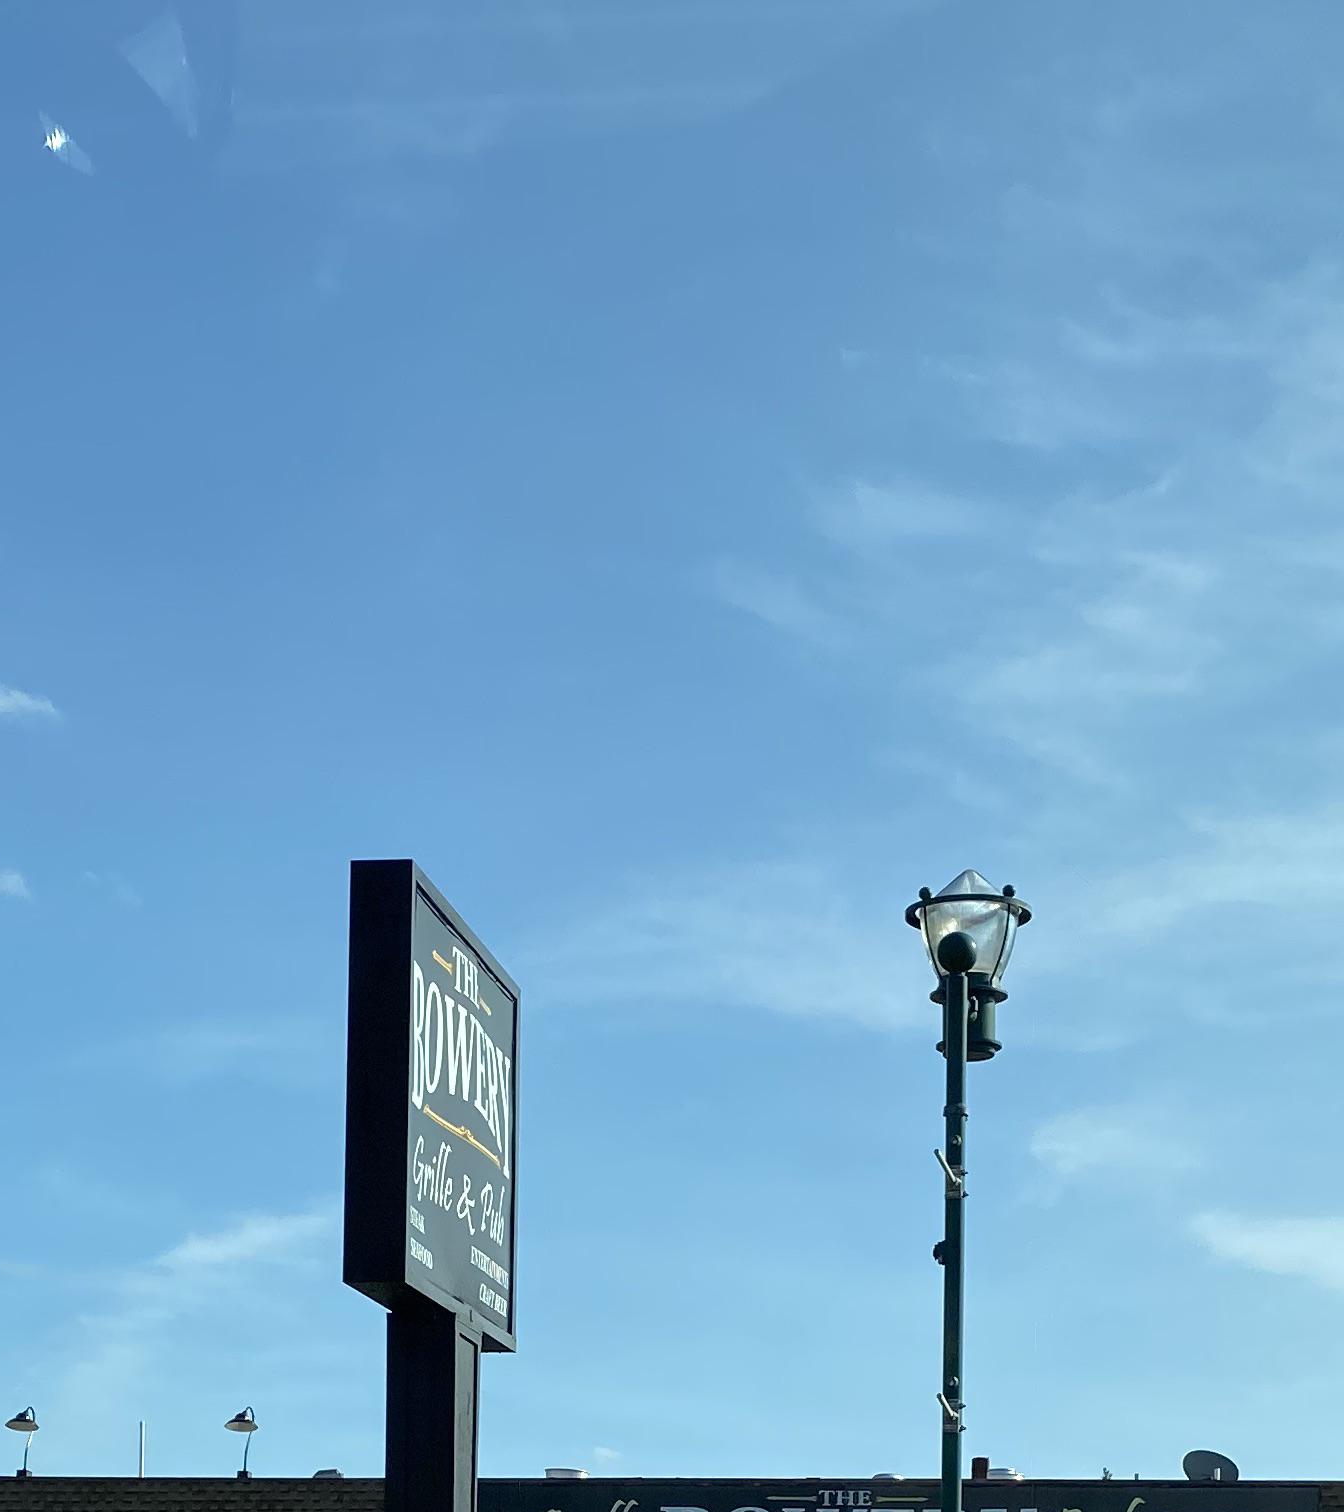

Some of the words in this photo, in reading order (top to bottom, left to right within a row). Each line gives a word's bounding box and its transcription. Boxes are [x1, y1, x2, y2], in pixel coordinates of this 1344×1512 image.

[452, 946, 480, 1010] THE
[411, 960, 511, 1179] BOWERY
[413, 1135, 453, 1212] Grille
[456, 1174, 475, 1236] &
[480, 1181, 506, 1247] Pub
[818, 1490, 873, 1506] THE
